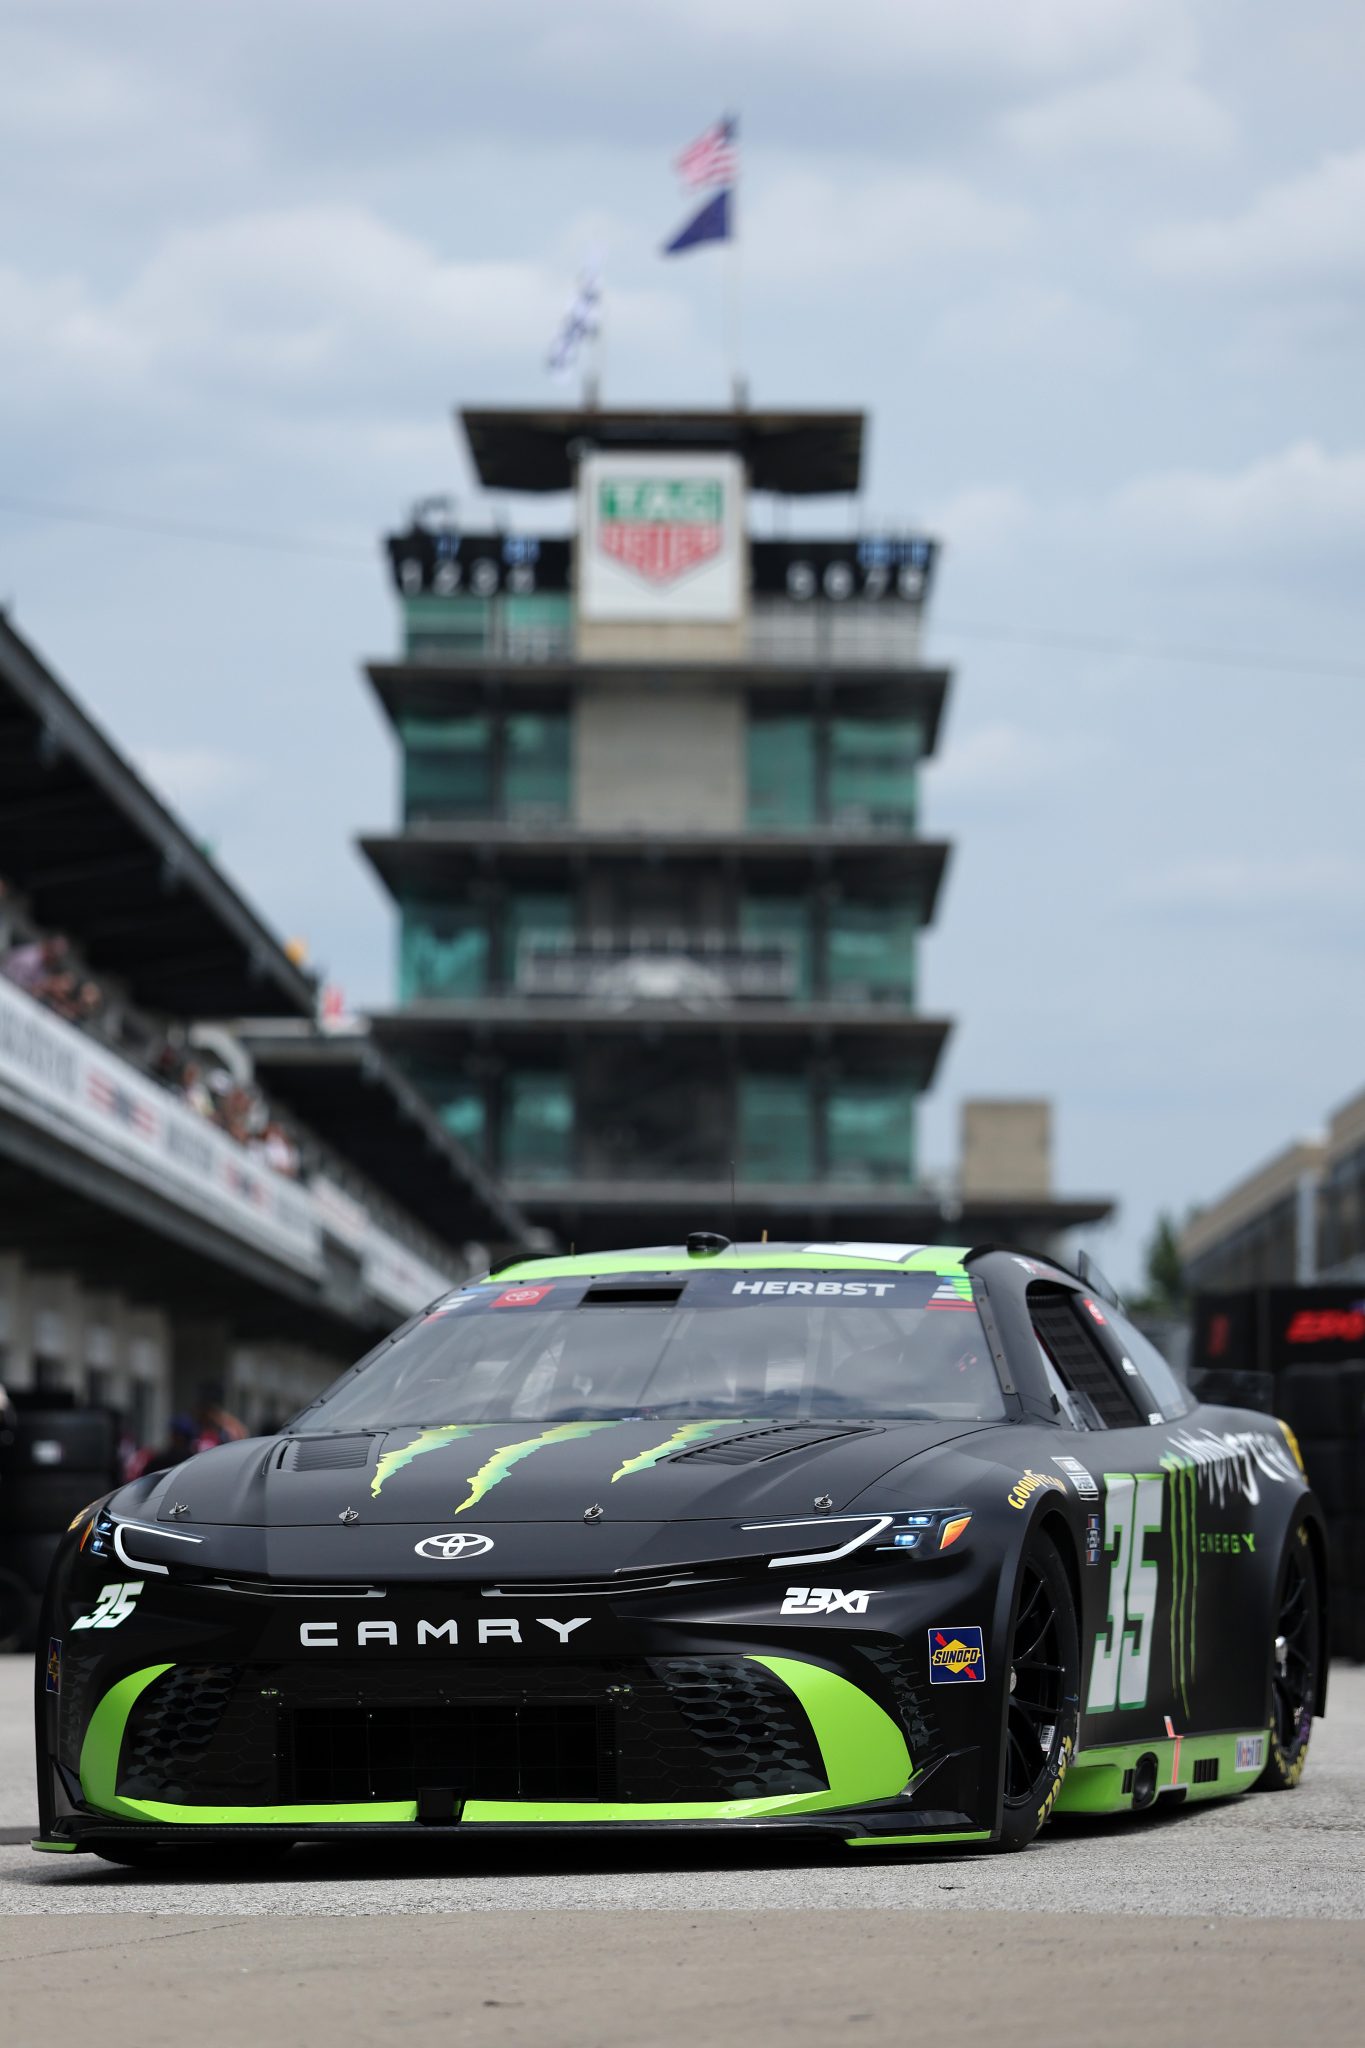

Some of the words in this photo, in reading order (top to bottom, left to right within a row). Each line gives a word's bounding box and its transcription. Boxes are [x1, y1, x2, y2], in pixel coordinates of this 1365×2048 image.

[731, 1280, 896, 1297] HERBST
[1200, 1532, 1256, 1553] ENERGY
[1086, 1472, 1165, 1714] 35
[70, 1581, 145, 1631] 35
[299, 1617, 593, 1647] CAMRY
[933, 1648, 979, 1665] SUNOCO
